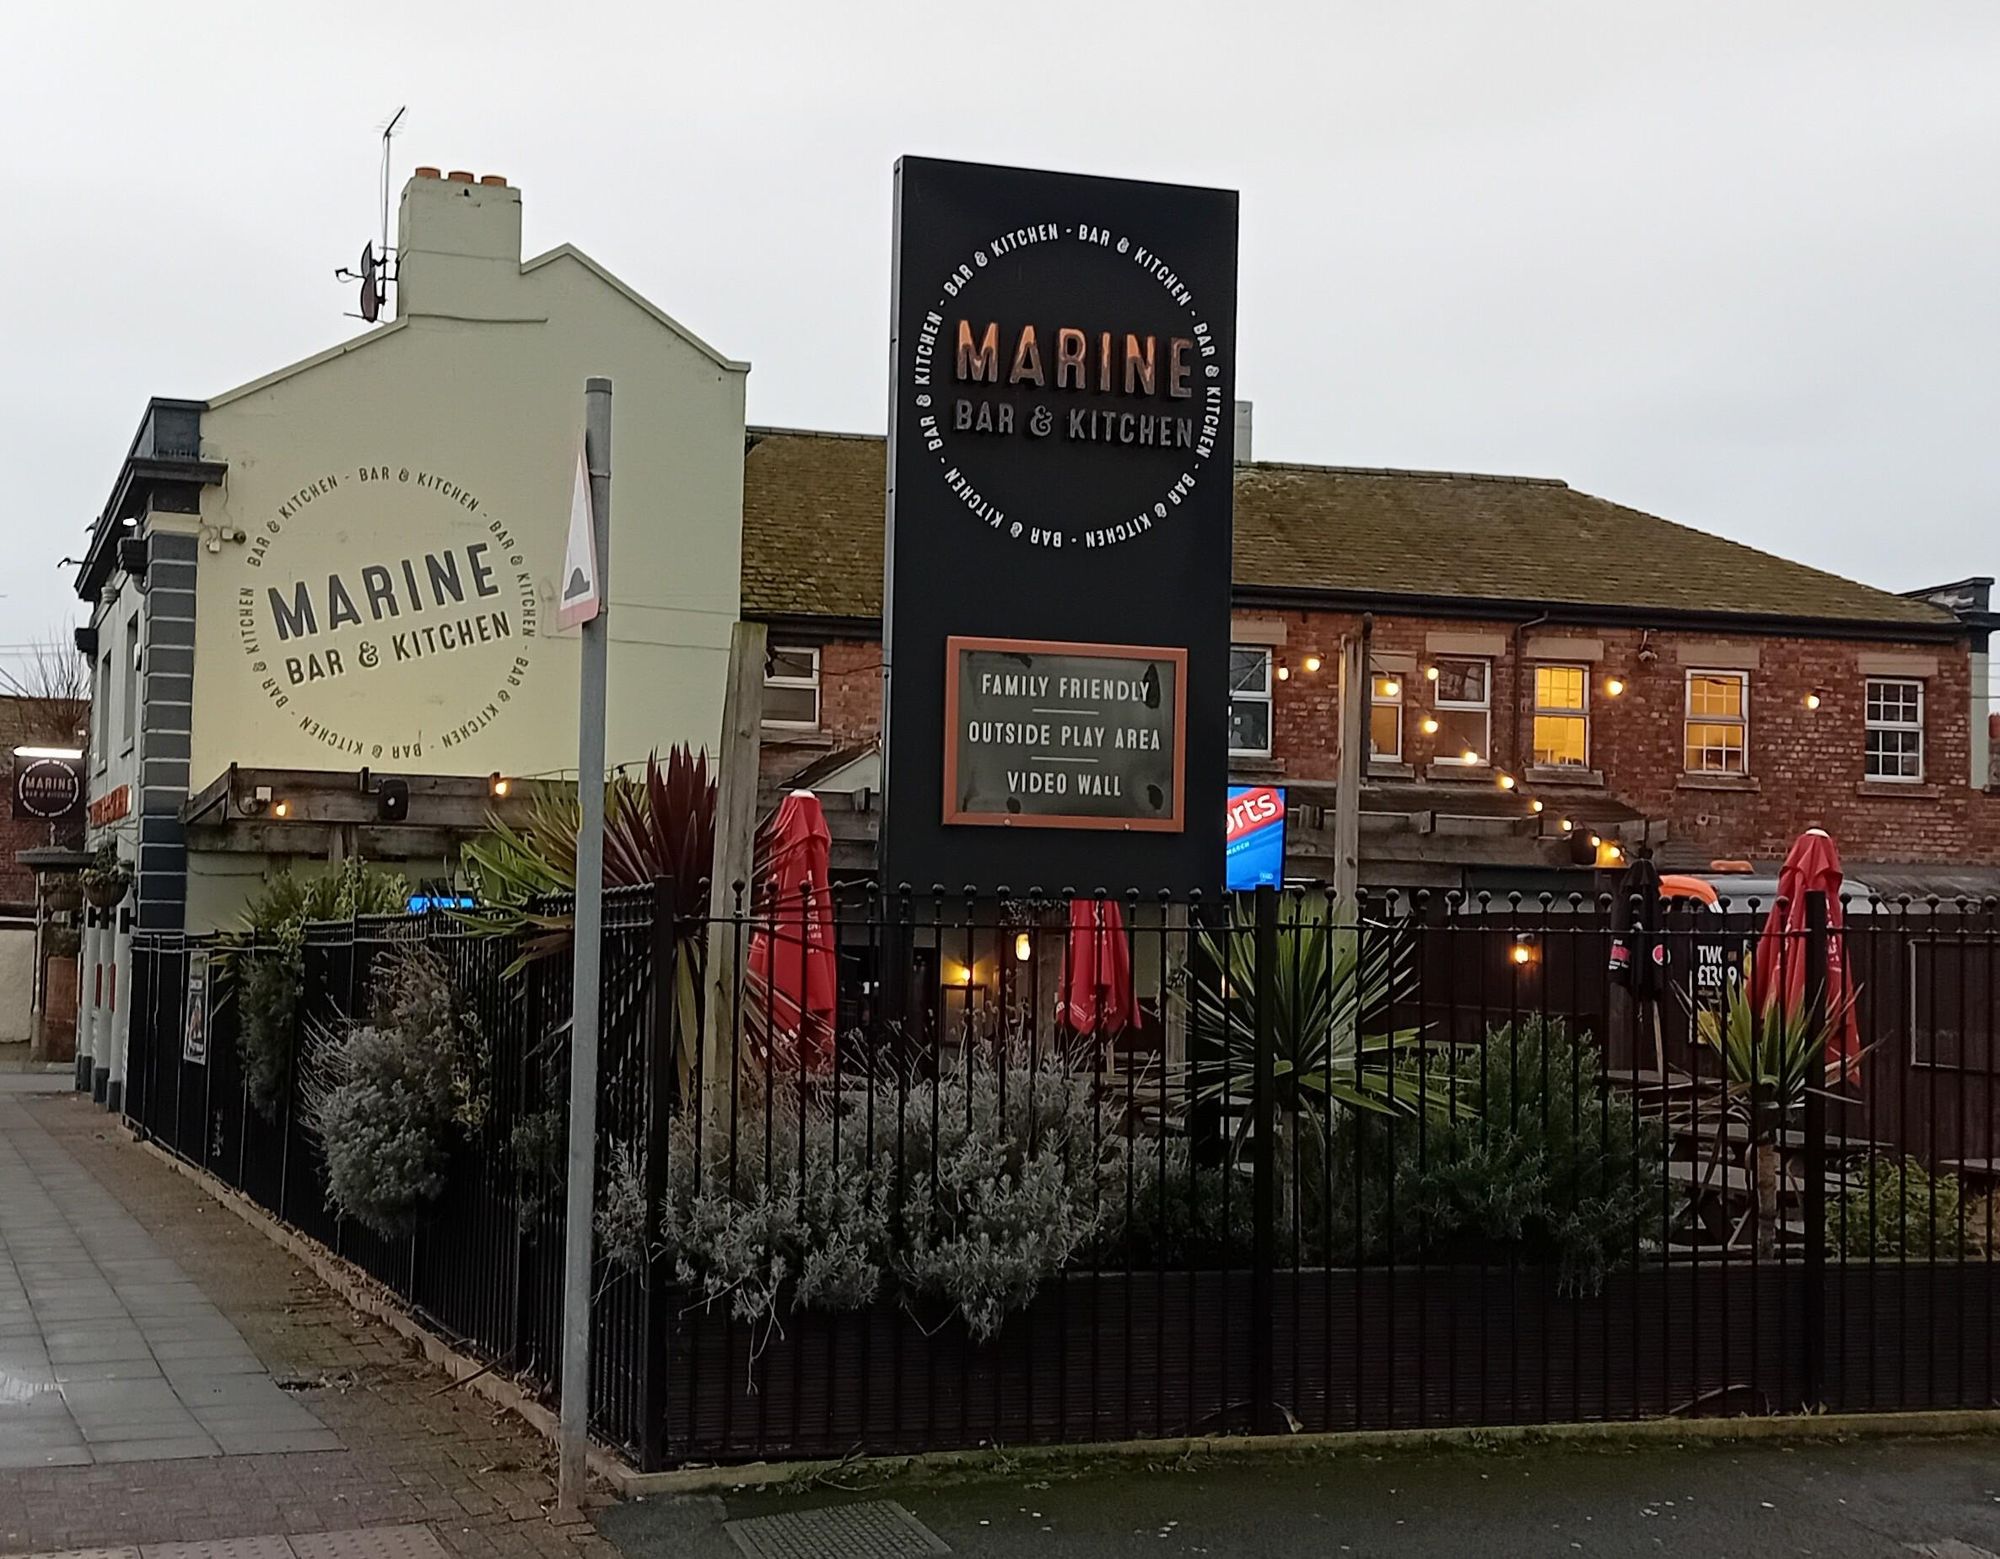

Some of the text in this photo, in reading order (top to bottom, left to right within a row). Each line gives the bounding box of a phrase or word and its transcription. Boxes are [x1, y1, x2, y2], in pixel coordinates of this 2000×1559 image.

[943, 223, 1058, 297] BAR & KITCHEN
[1079, 224, 1192, 306] BAR & KITCHEN
[914, 311, 943, 451] BAR & KITCHEN
[956, 319, 1194, 398] MARINE
[1193, 322, 1222, 459] BAR & KITCHEN
[955, 399, 1193, 448] BAR & KITCHEN
[247, 475, 338, 567] BAR & KITCHEN
[359, 466, 480, 512] BAR & KITCHEN
[944, 467, 1062, 548] BAR & KITCHEN
[1085, 472, 1196, 548] BAR & KITCHEN
[267, 542, 500, 641] MARINE
[489, 520, 537, 638] BAR & KITCHEN
[239, 587, 289, 708] BAR & KITCHEN
[285, 610, 512, 686] BAR & KITCHEN
[441, 656, 529, 748] BAR & KITCHEN
[982, 673, 1150, 702] FAMILY FRIENDLY
[300, 715, 422, 759] BAR & KITCHEN
[968, 721, 1161, 751] OUTSIDE PLAY AREA
[25, 776, 73, 791] MARINE
[1007, 771, 1122, 797] VIDEO WALL
